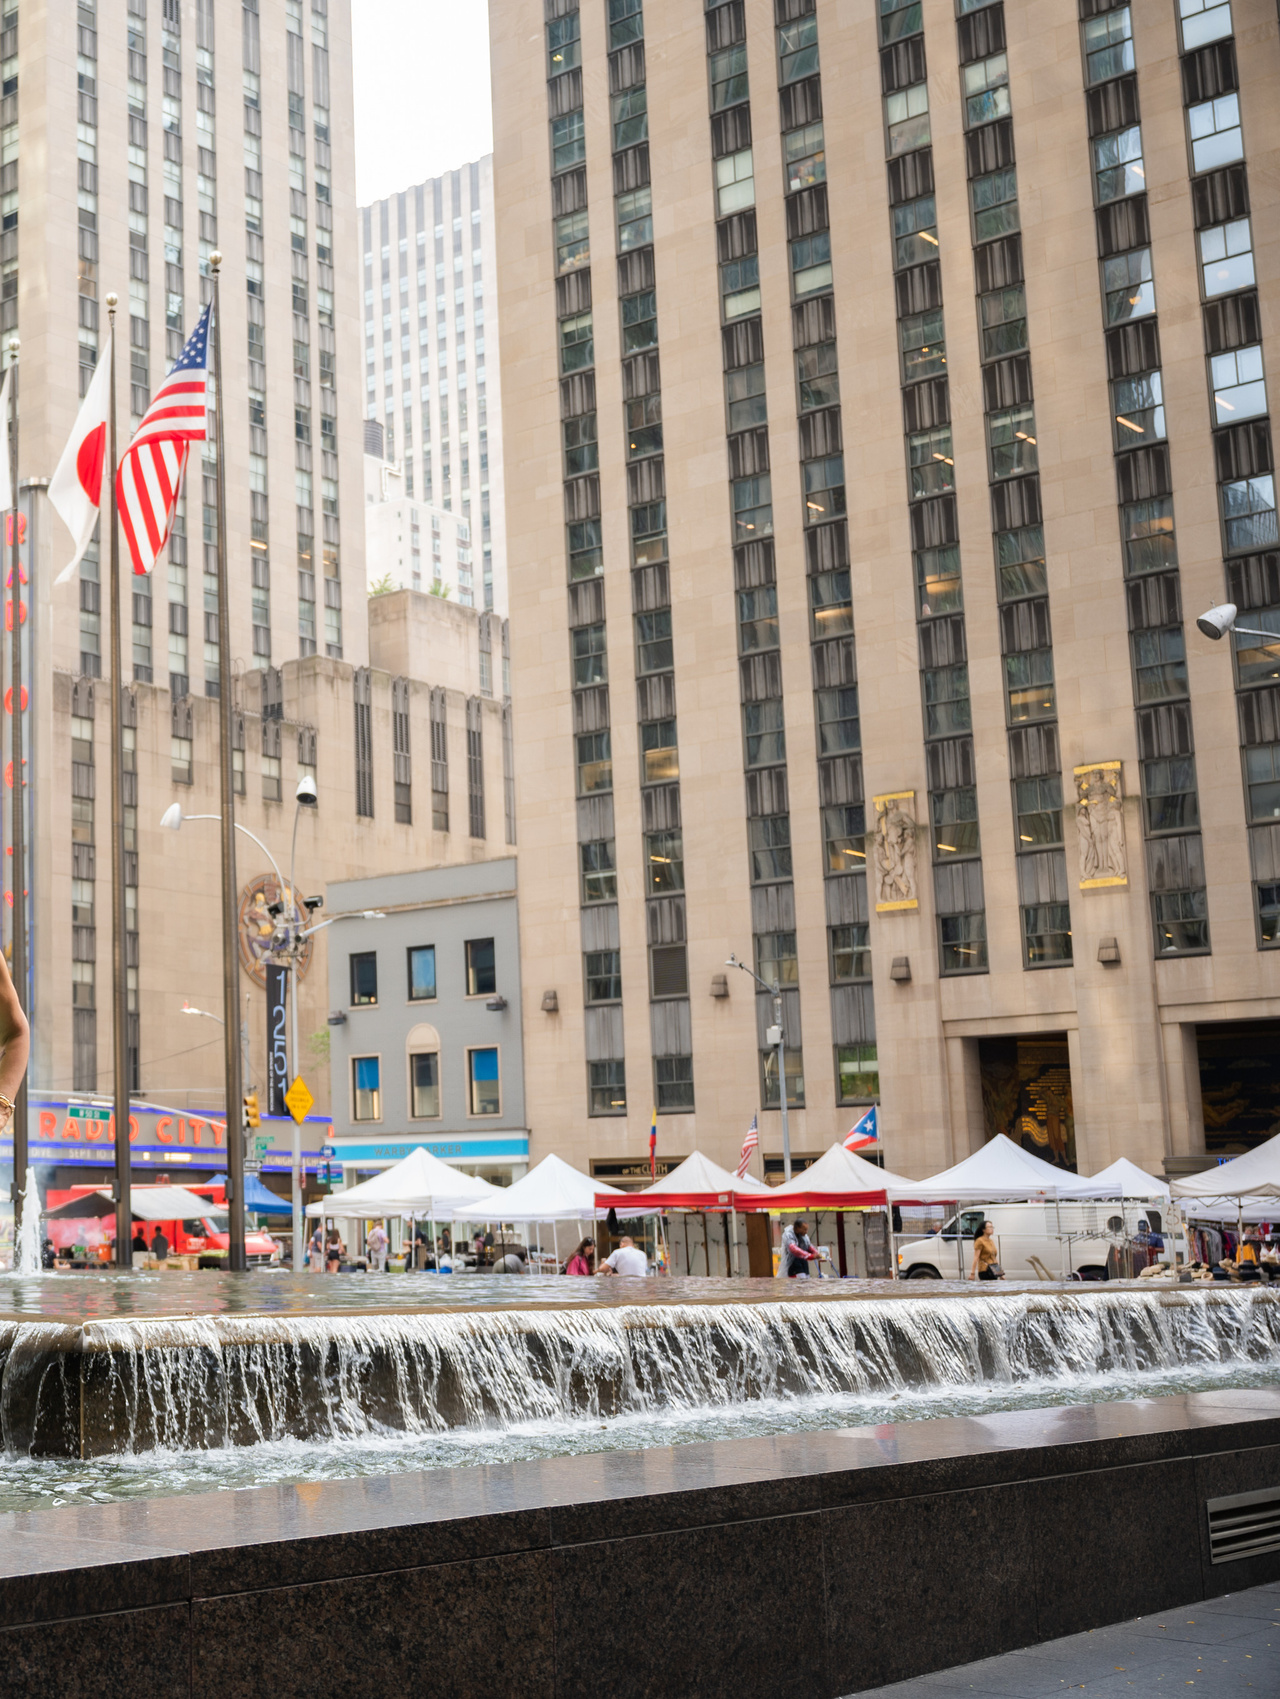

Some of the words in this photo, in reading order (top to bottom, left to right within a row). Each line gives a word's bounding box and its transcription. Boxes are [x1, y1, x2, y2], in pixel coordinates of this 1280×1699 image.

[273, 970, 288, 1112] 1251
[156, 1116, 227, 1145] CITY
[374, 1145, 412, 1157] WARBY
[425, 1144, 462, 1155] ARKER
